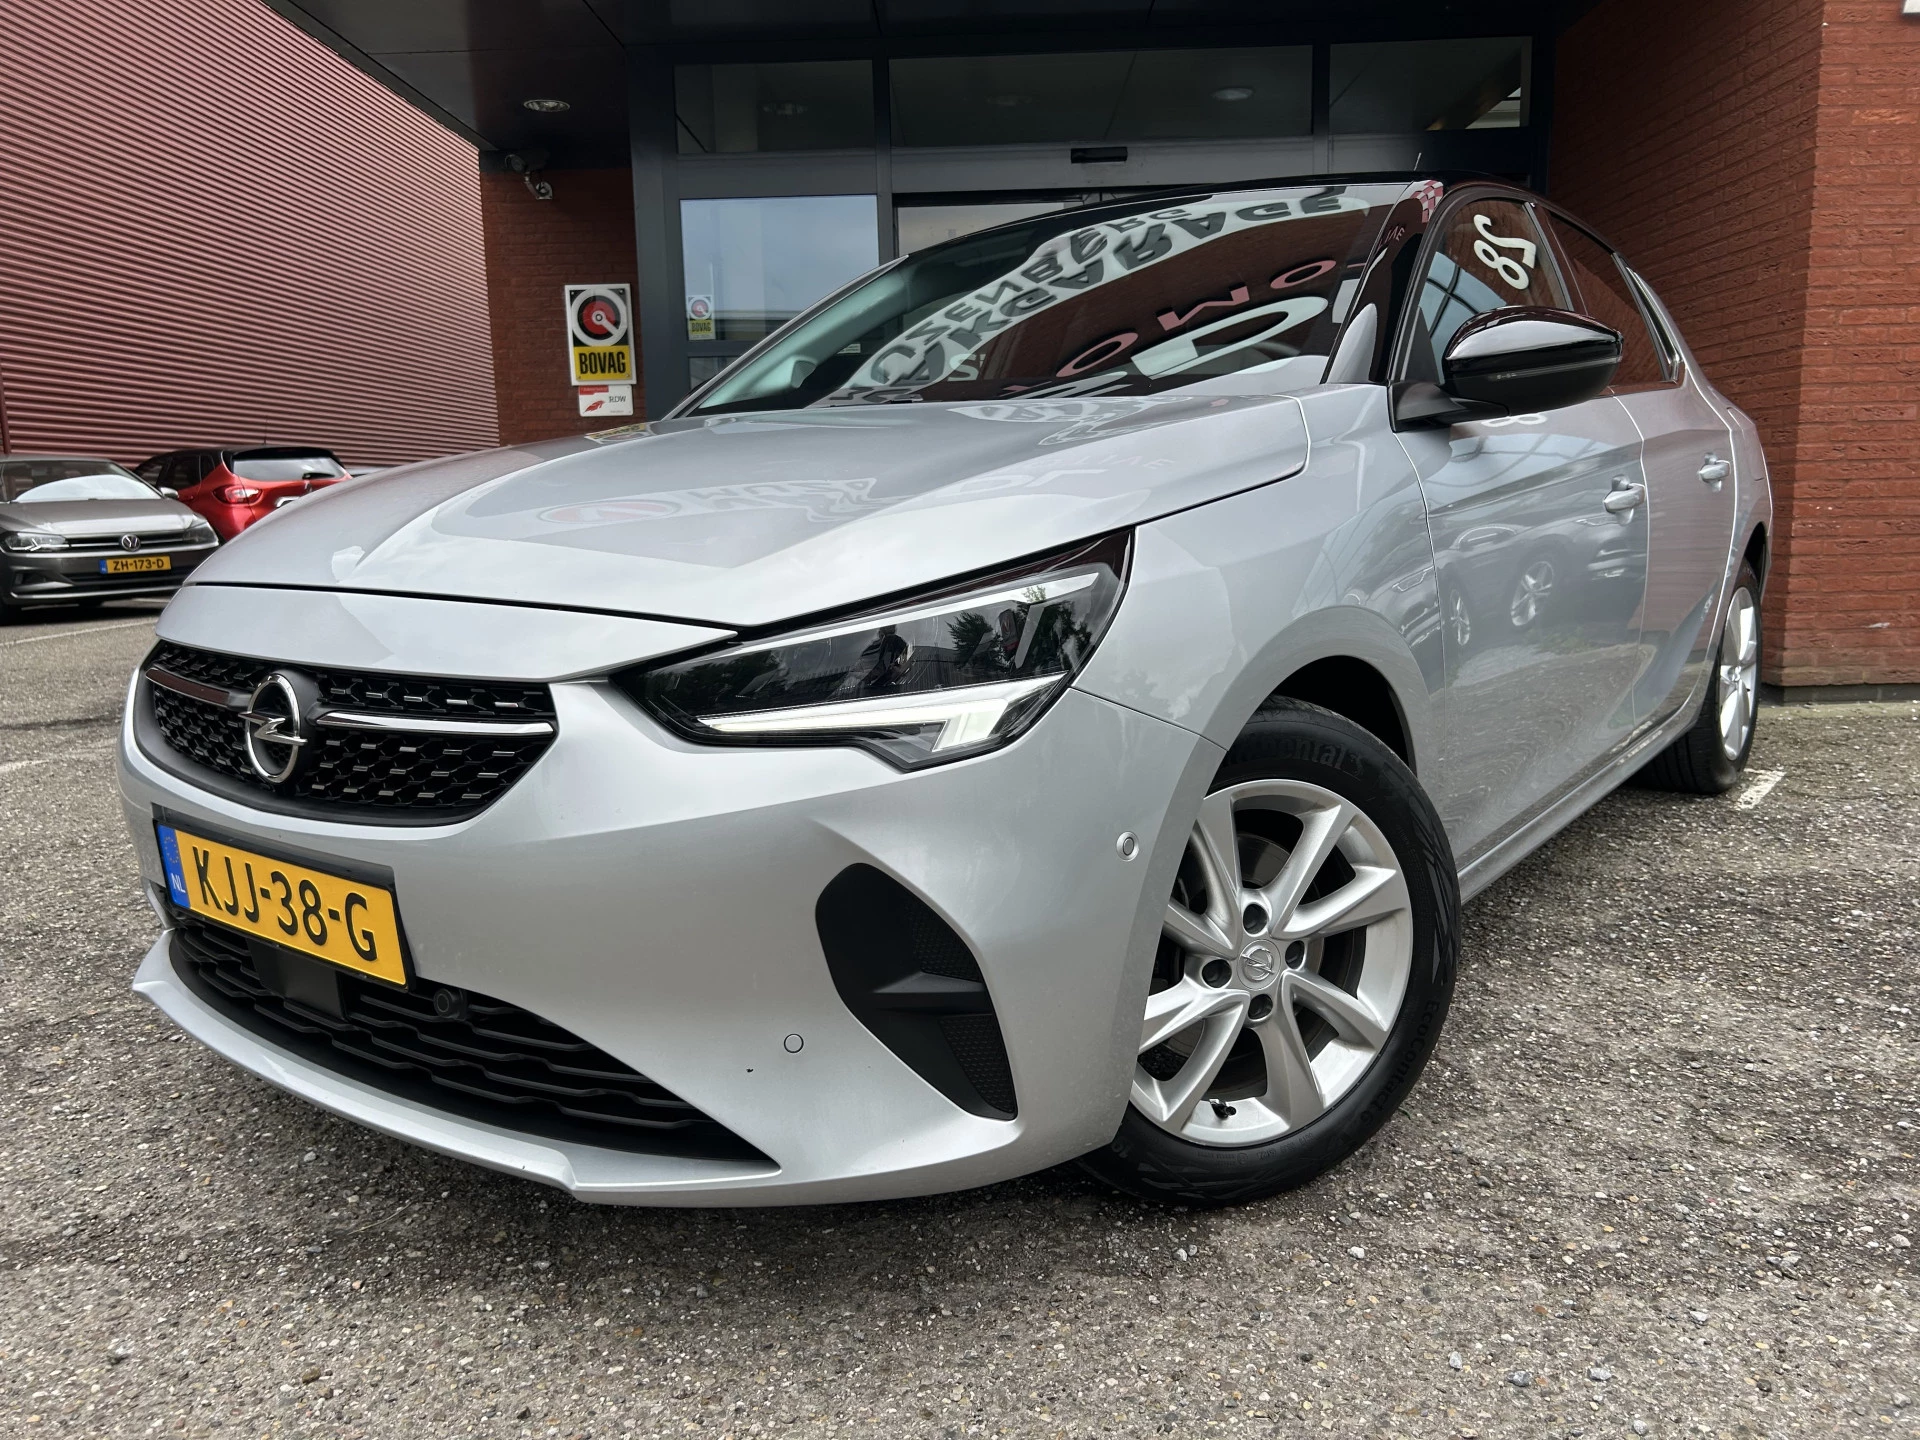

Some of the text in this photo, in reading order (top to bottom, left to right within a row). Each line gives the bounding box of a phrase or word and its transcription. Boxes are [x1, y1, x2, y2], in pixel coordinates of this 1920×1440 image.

[578, 351, 626, 375] BOVAG
[608, 395, 627, 403] RDW
[112, 558, 164, 571] ZH-173-D
[171, 873, 186, 894] NL
[192, 846, 378, 962] KJJ-38-G
